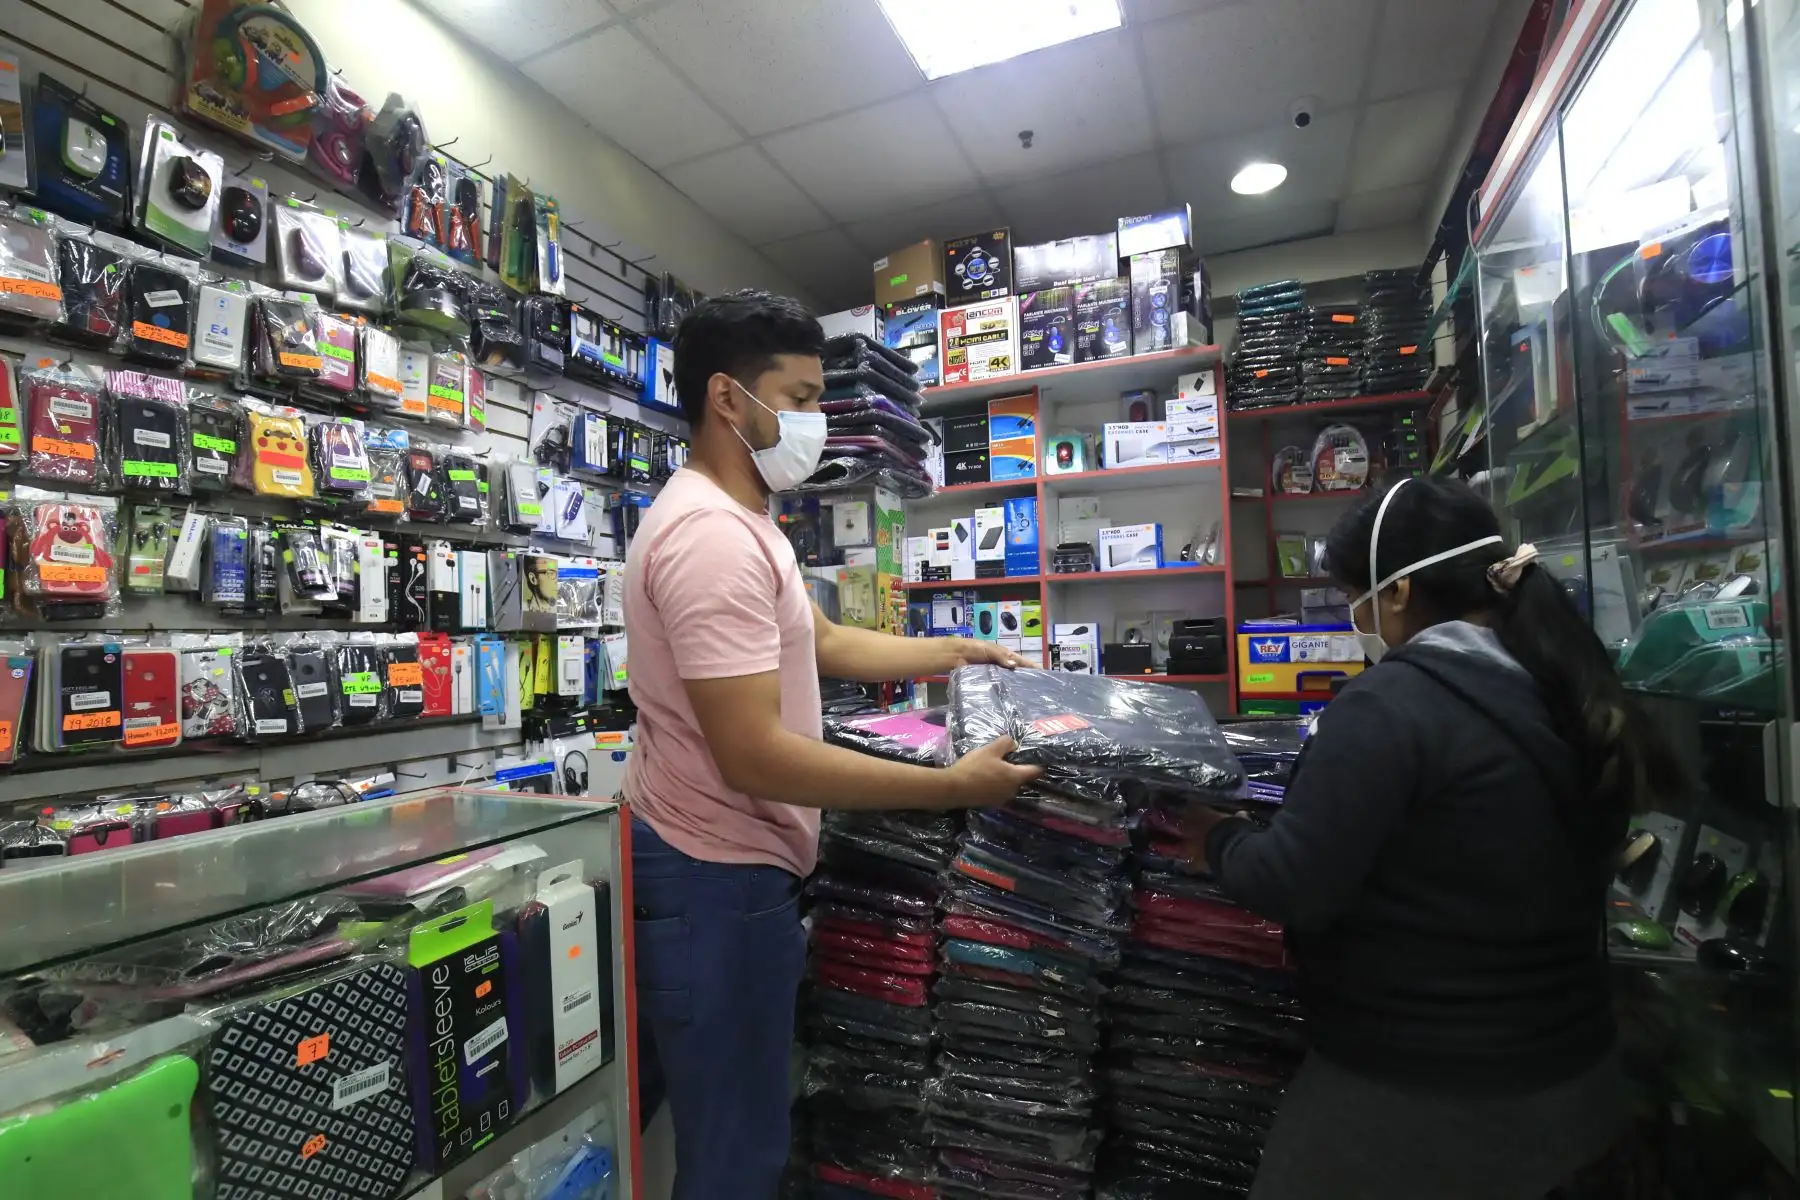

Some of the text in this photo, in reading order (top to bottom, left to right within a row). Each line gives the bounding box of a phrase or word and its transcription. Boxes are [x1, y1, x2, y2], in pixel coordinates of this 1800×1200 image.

[210, 323, 229, 336] E4
[990, 356, 1009, 368] 4K
[955, 461, 968, 471] 4K
[1260, 644, 1281, 653] REY
[1291, 641, 1329, 649] GIGANTE
[87, 716, 112, 729] 2018
[475, 999, 502, 1016] Kolours
[429, 964, 460, 1138] tabletsleeve
